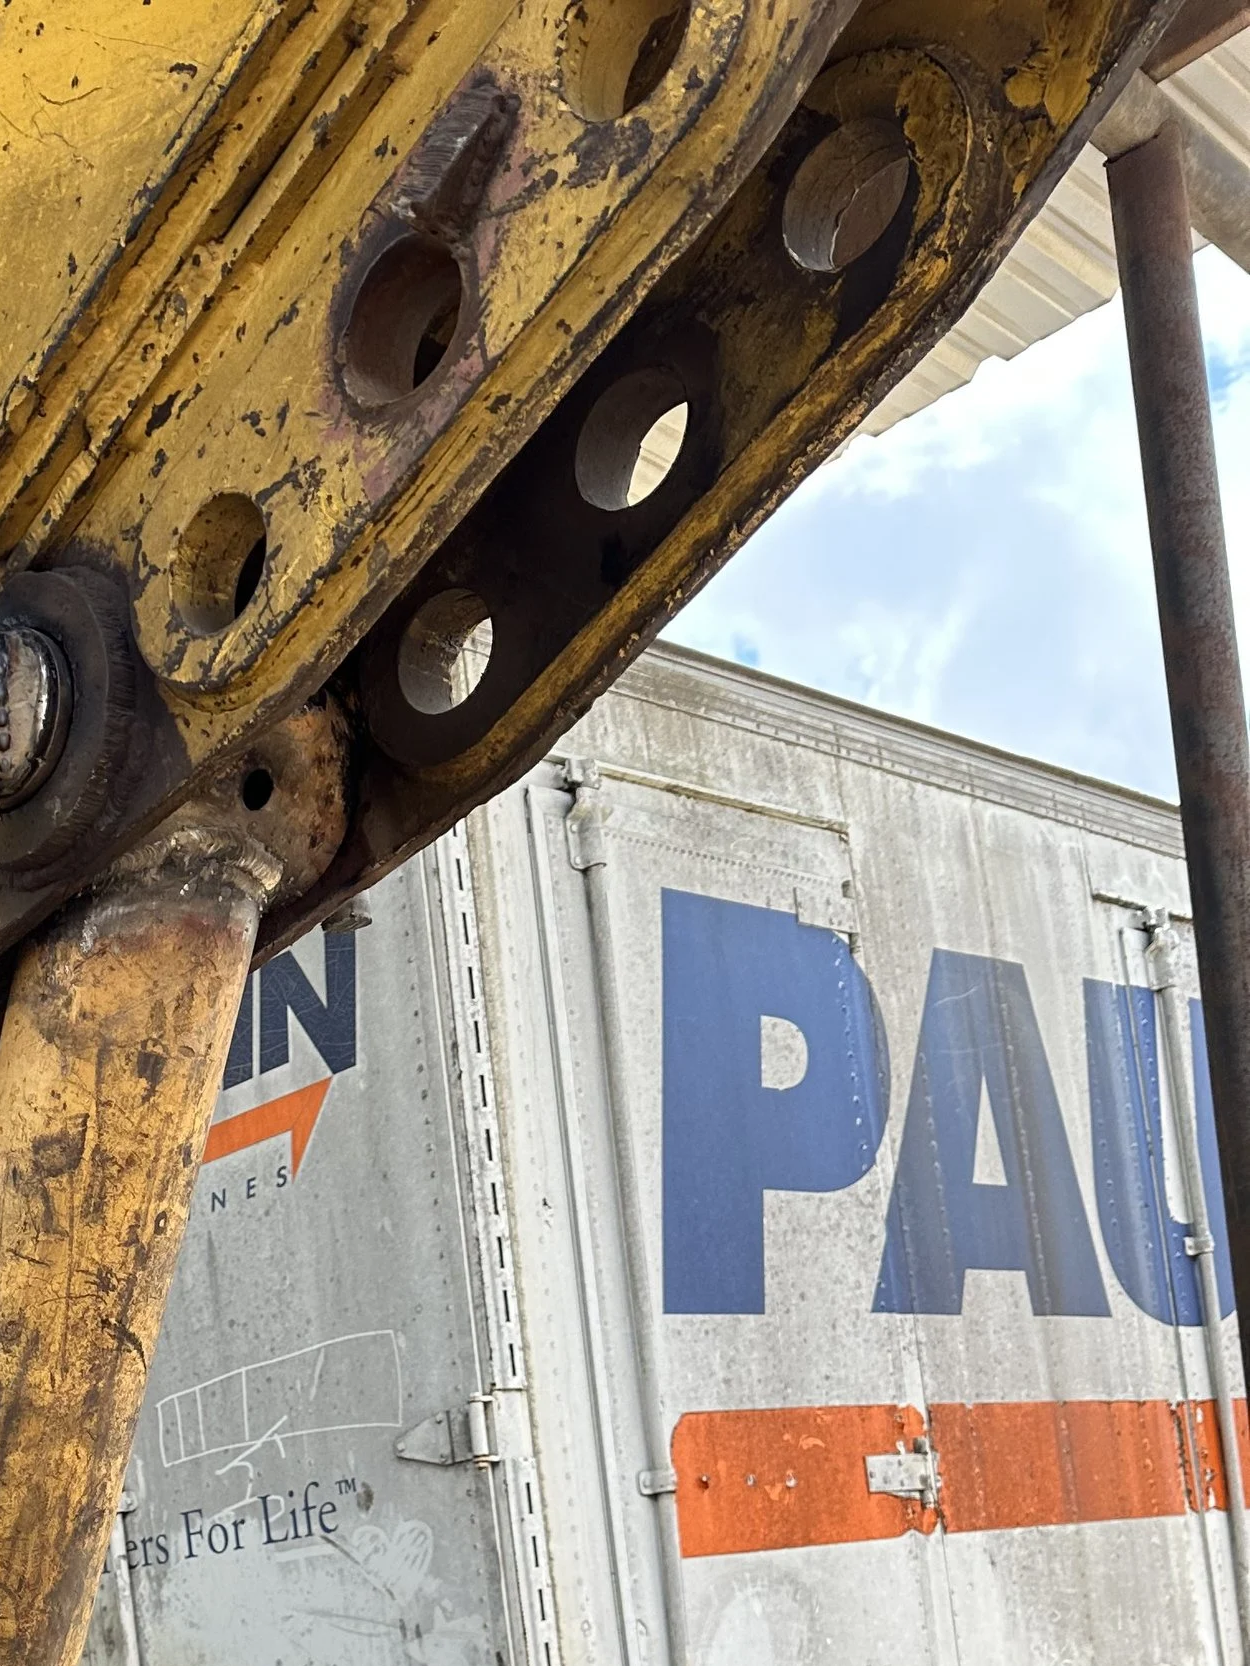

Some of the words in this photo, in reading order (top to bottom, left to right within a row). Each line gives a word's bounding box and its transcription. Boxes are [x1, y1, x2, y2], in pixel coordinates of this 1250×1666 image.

[211, 1166, 288, 1213] NES
[103, 1533, 170, 1575] ers
[180, 1508, 246, 1560] For
